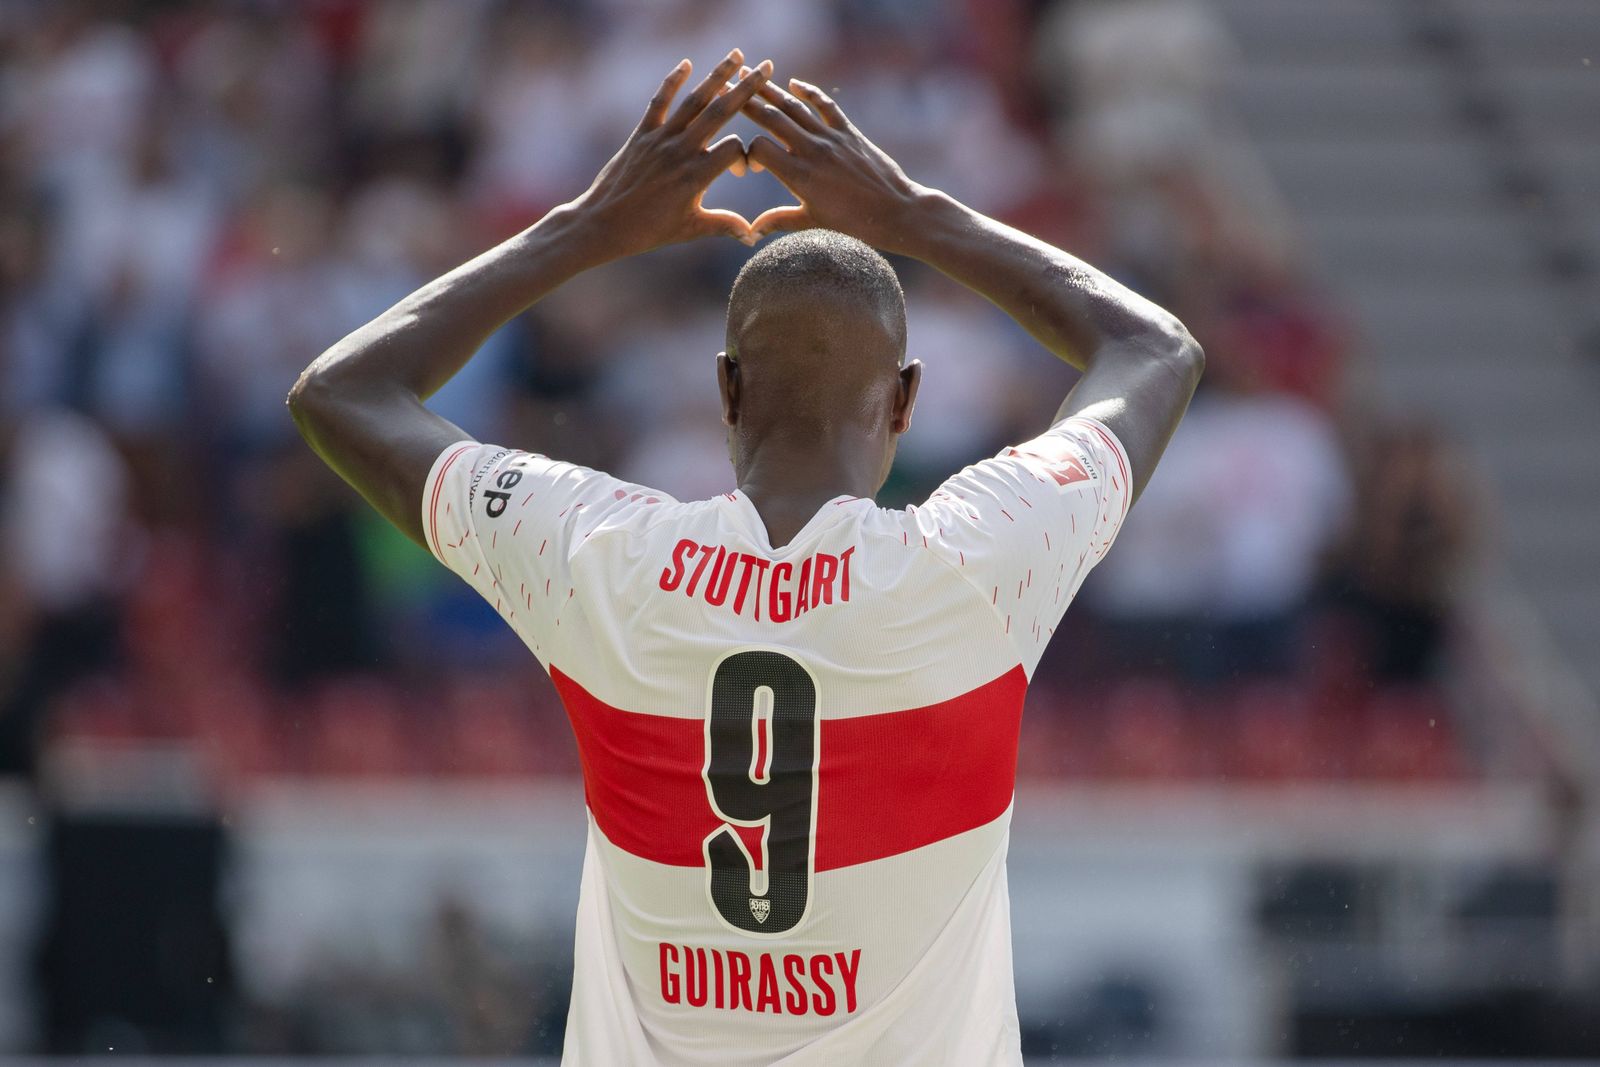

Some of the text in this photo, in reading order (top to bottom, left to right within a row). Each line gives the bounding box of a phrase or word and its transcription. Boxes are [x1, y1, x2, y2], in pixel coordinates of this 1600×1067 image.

[483, 458, 530, 518] ep
[659, 538, 855, 623] STUTTGART
[701, 644, 821, 939] 9
[659, 942, 862, 1017] GUIRASSY
